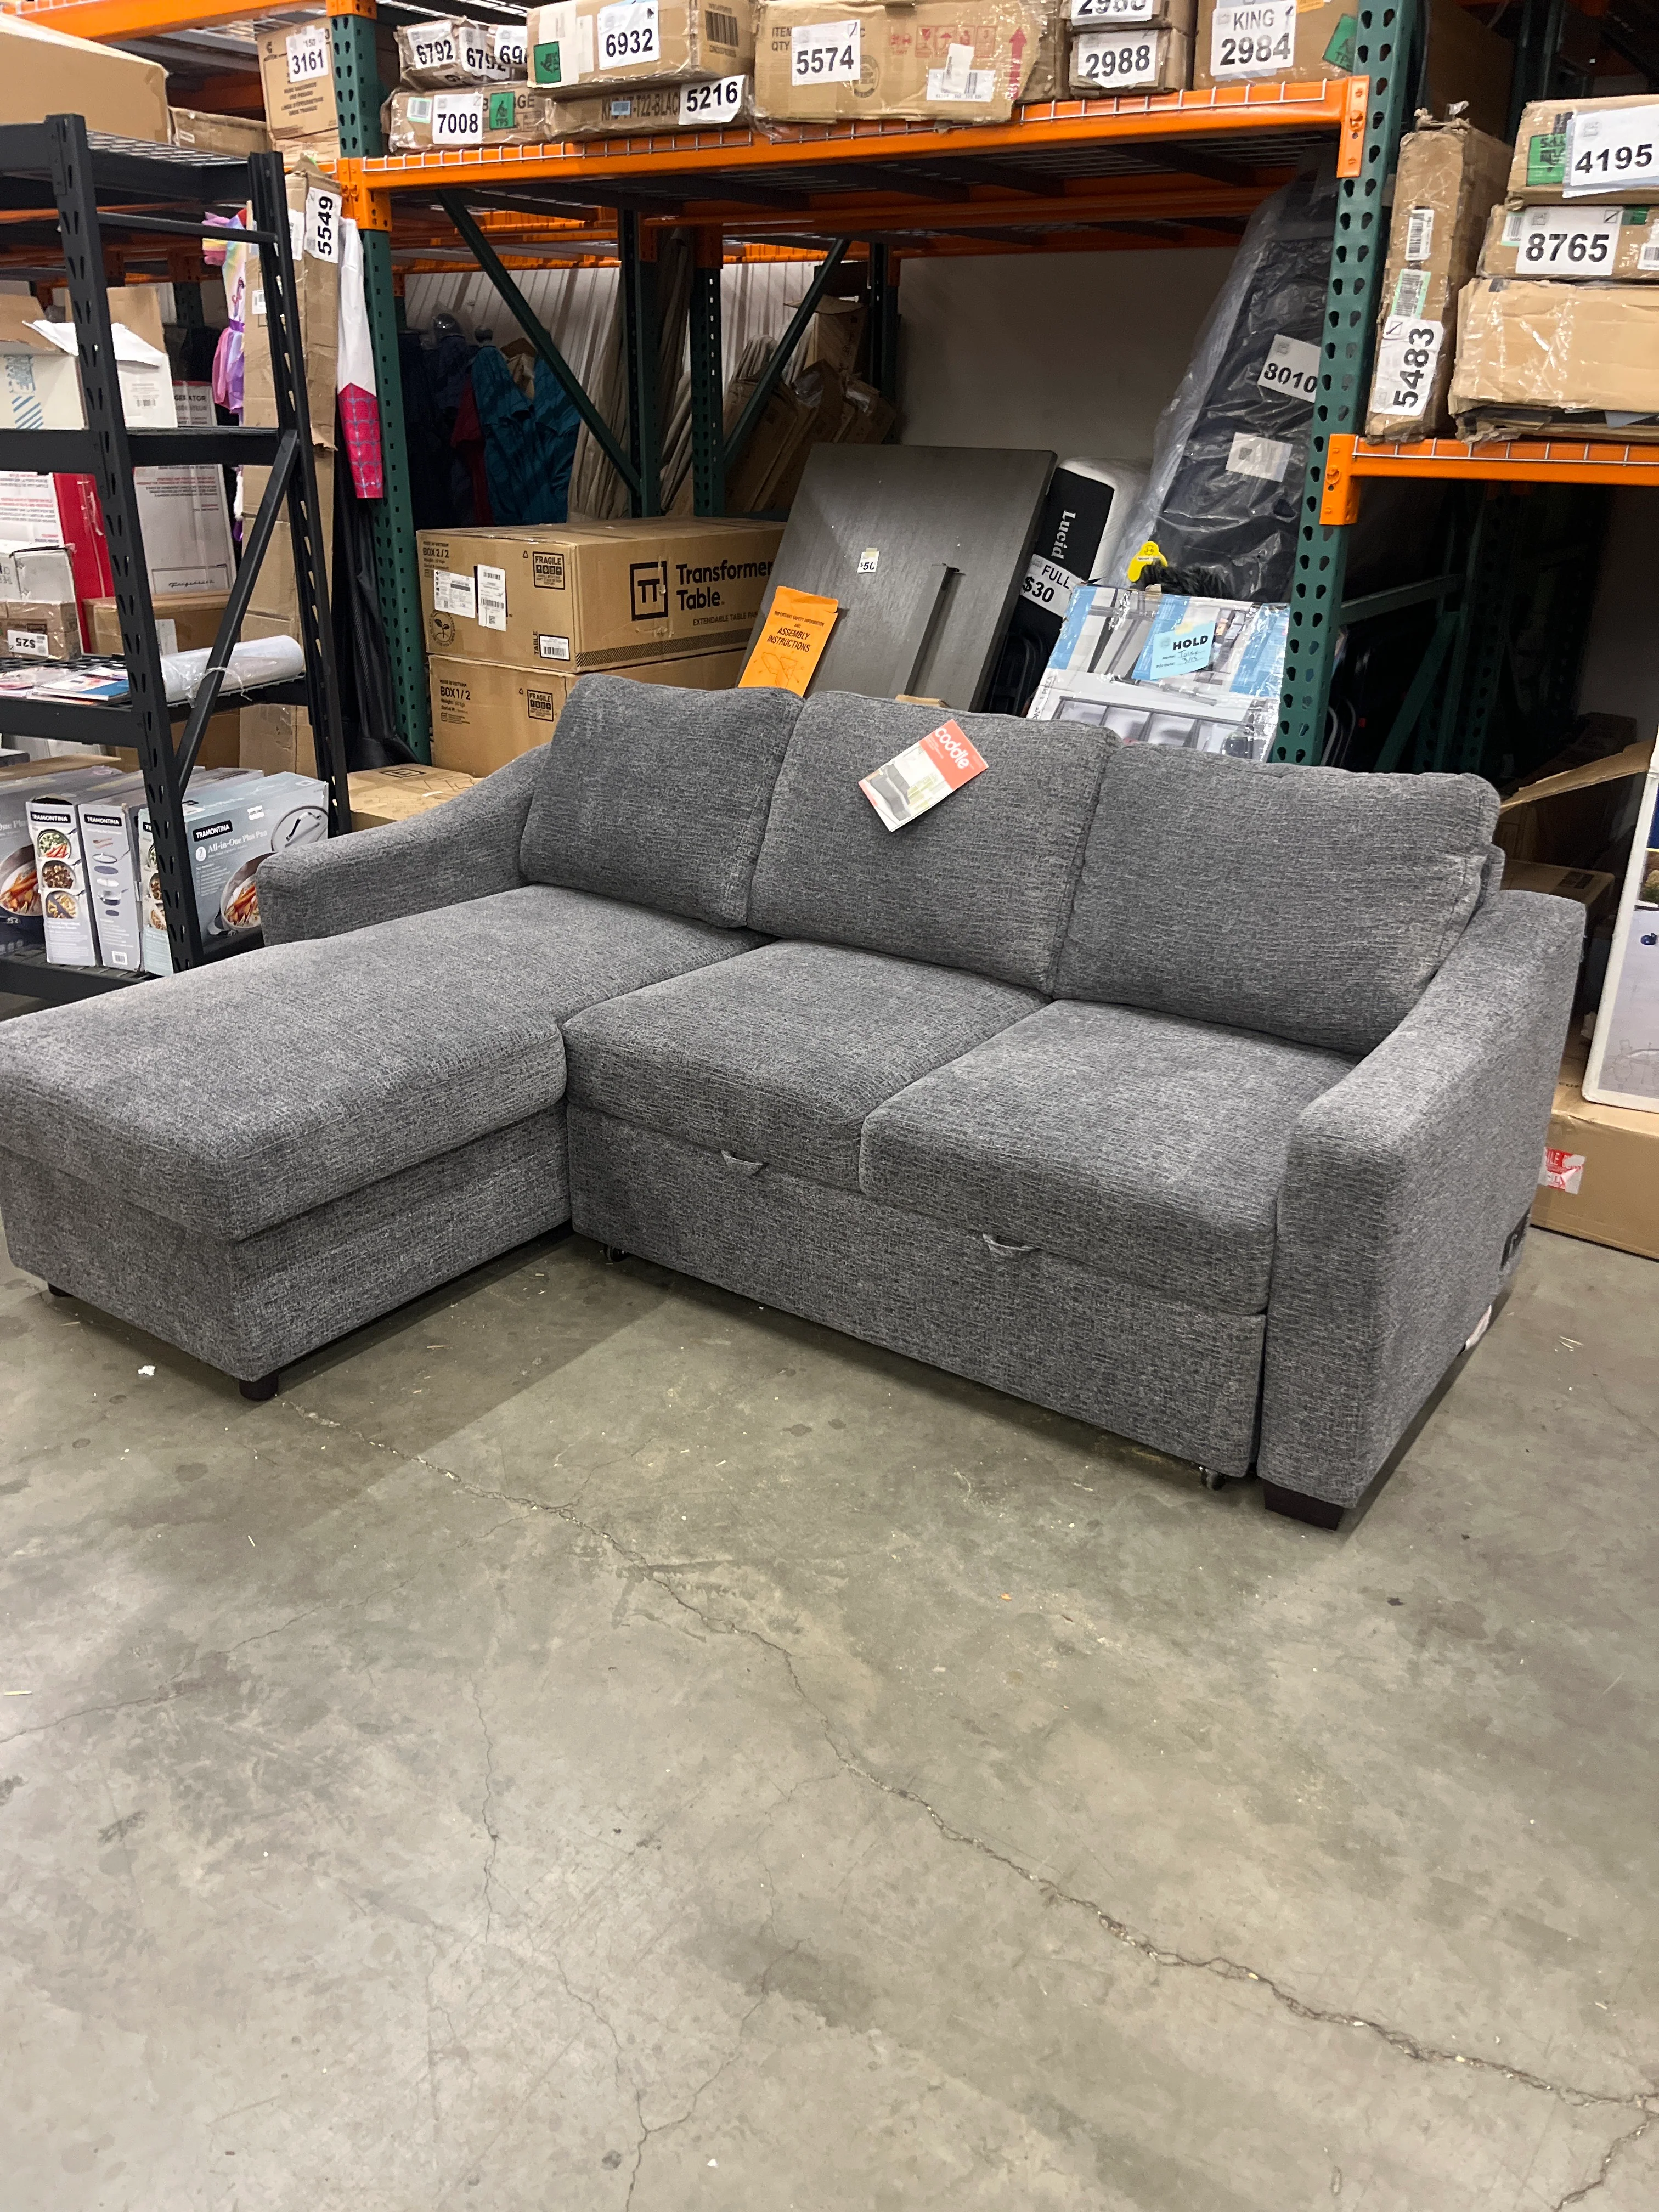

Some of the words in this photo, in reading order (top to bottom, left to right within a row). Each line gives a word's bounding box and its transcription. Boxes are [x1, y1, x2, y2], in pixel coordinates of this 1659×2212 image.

[1234, 9, 1274, 31] KING
[416, 40, 453, 65] 6792
[500, 45, 527, 64] 69
[606, 29, 653, 57] 6932
[772, 41, 790, 51] QTY
[1220, 33, 1290, 66] 2984
[292, 49, 323, 74] 3161
[796, 45, 854, 75] 5574
[1086, 45, 1150, 79] 2988
[687, 81, 737, 112] 5216
[437, 113, 478, 133] 7008
[1575, 143, 1653, 173] 4195
[318, 196, 333, 256] 5549
[1525, 233, 1610, 262] 8765
[1263, 363, 1318, 393] 8010
[1393, 328, 1434, 408] 5483
[1051, 509, 1076, 560] Lucid
[423, 548, 435, 556] BOX
[535, 556, 562, 565] FRAGILE
[1042, 565, 1069, 589] FULL
[1022, 576, 1054, 603] $30
[693, 616, 729, 625] EXTENDABLE
[730, 612, 747, 620] TABLE
[15, 637, 36, 648] $25
[767, 635, 811, 652] INSTRUCTIONS
[777, 627, 810, 641] ASSEMBLY
[1173, 635, 1209, 651] HOLD
[440, 686, 455, 698] BOX
[529, 693, 551, 702] FRAGILE
[935, 727, 969, 769] coddle
[32, 814, 68, 822] TRAMONTINA
[86, 816, 120, 825] TRAMONTINA
[195, 824, 230, 839] TRAMONTINA
[208, 838, 242, 854] All-in-One
[242, 834, 255, 842] Plus
[256, 830, 268, 838] Pan
